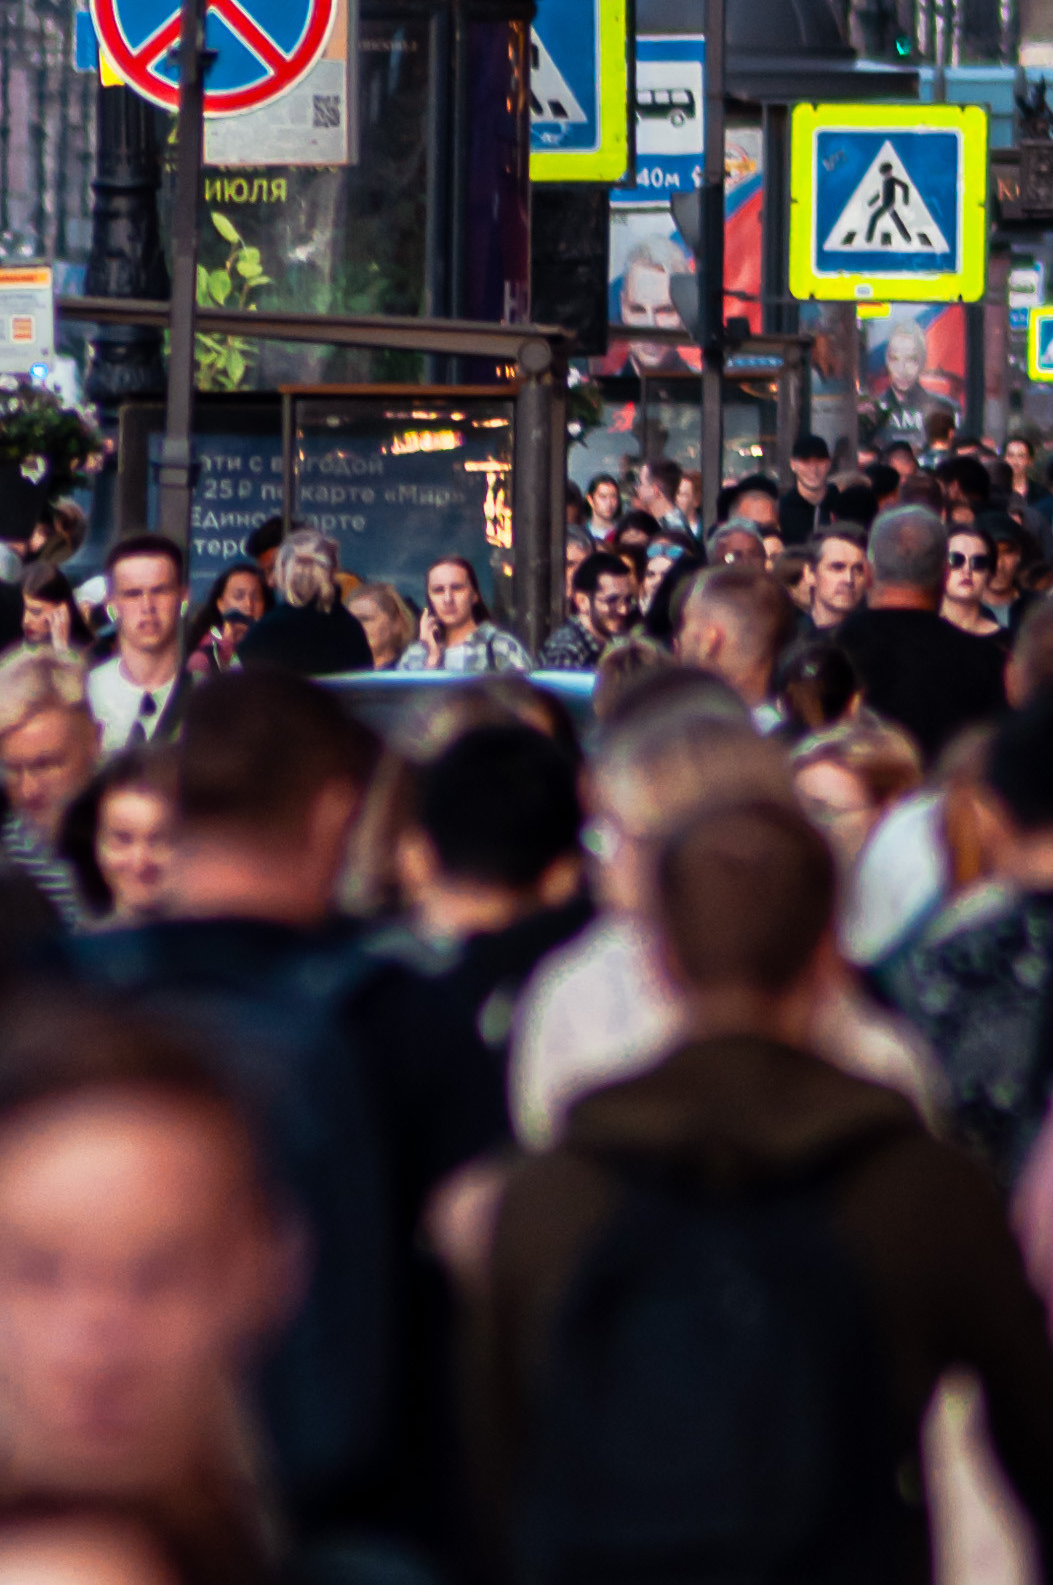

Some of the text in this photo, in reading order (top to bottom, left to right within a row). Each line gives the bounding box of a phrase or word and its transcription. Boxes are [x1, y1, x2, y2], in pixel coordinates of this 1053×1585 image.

[637, 166, 680, 188] 40м
[271, 452, 383, 475] вгодой
[204, 479, 233, 500] 25
[300, 483, 375, 504] карте
